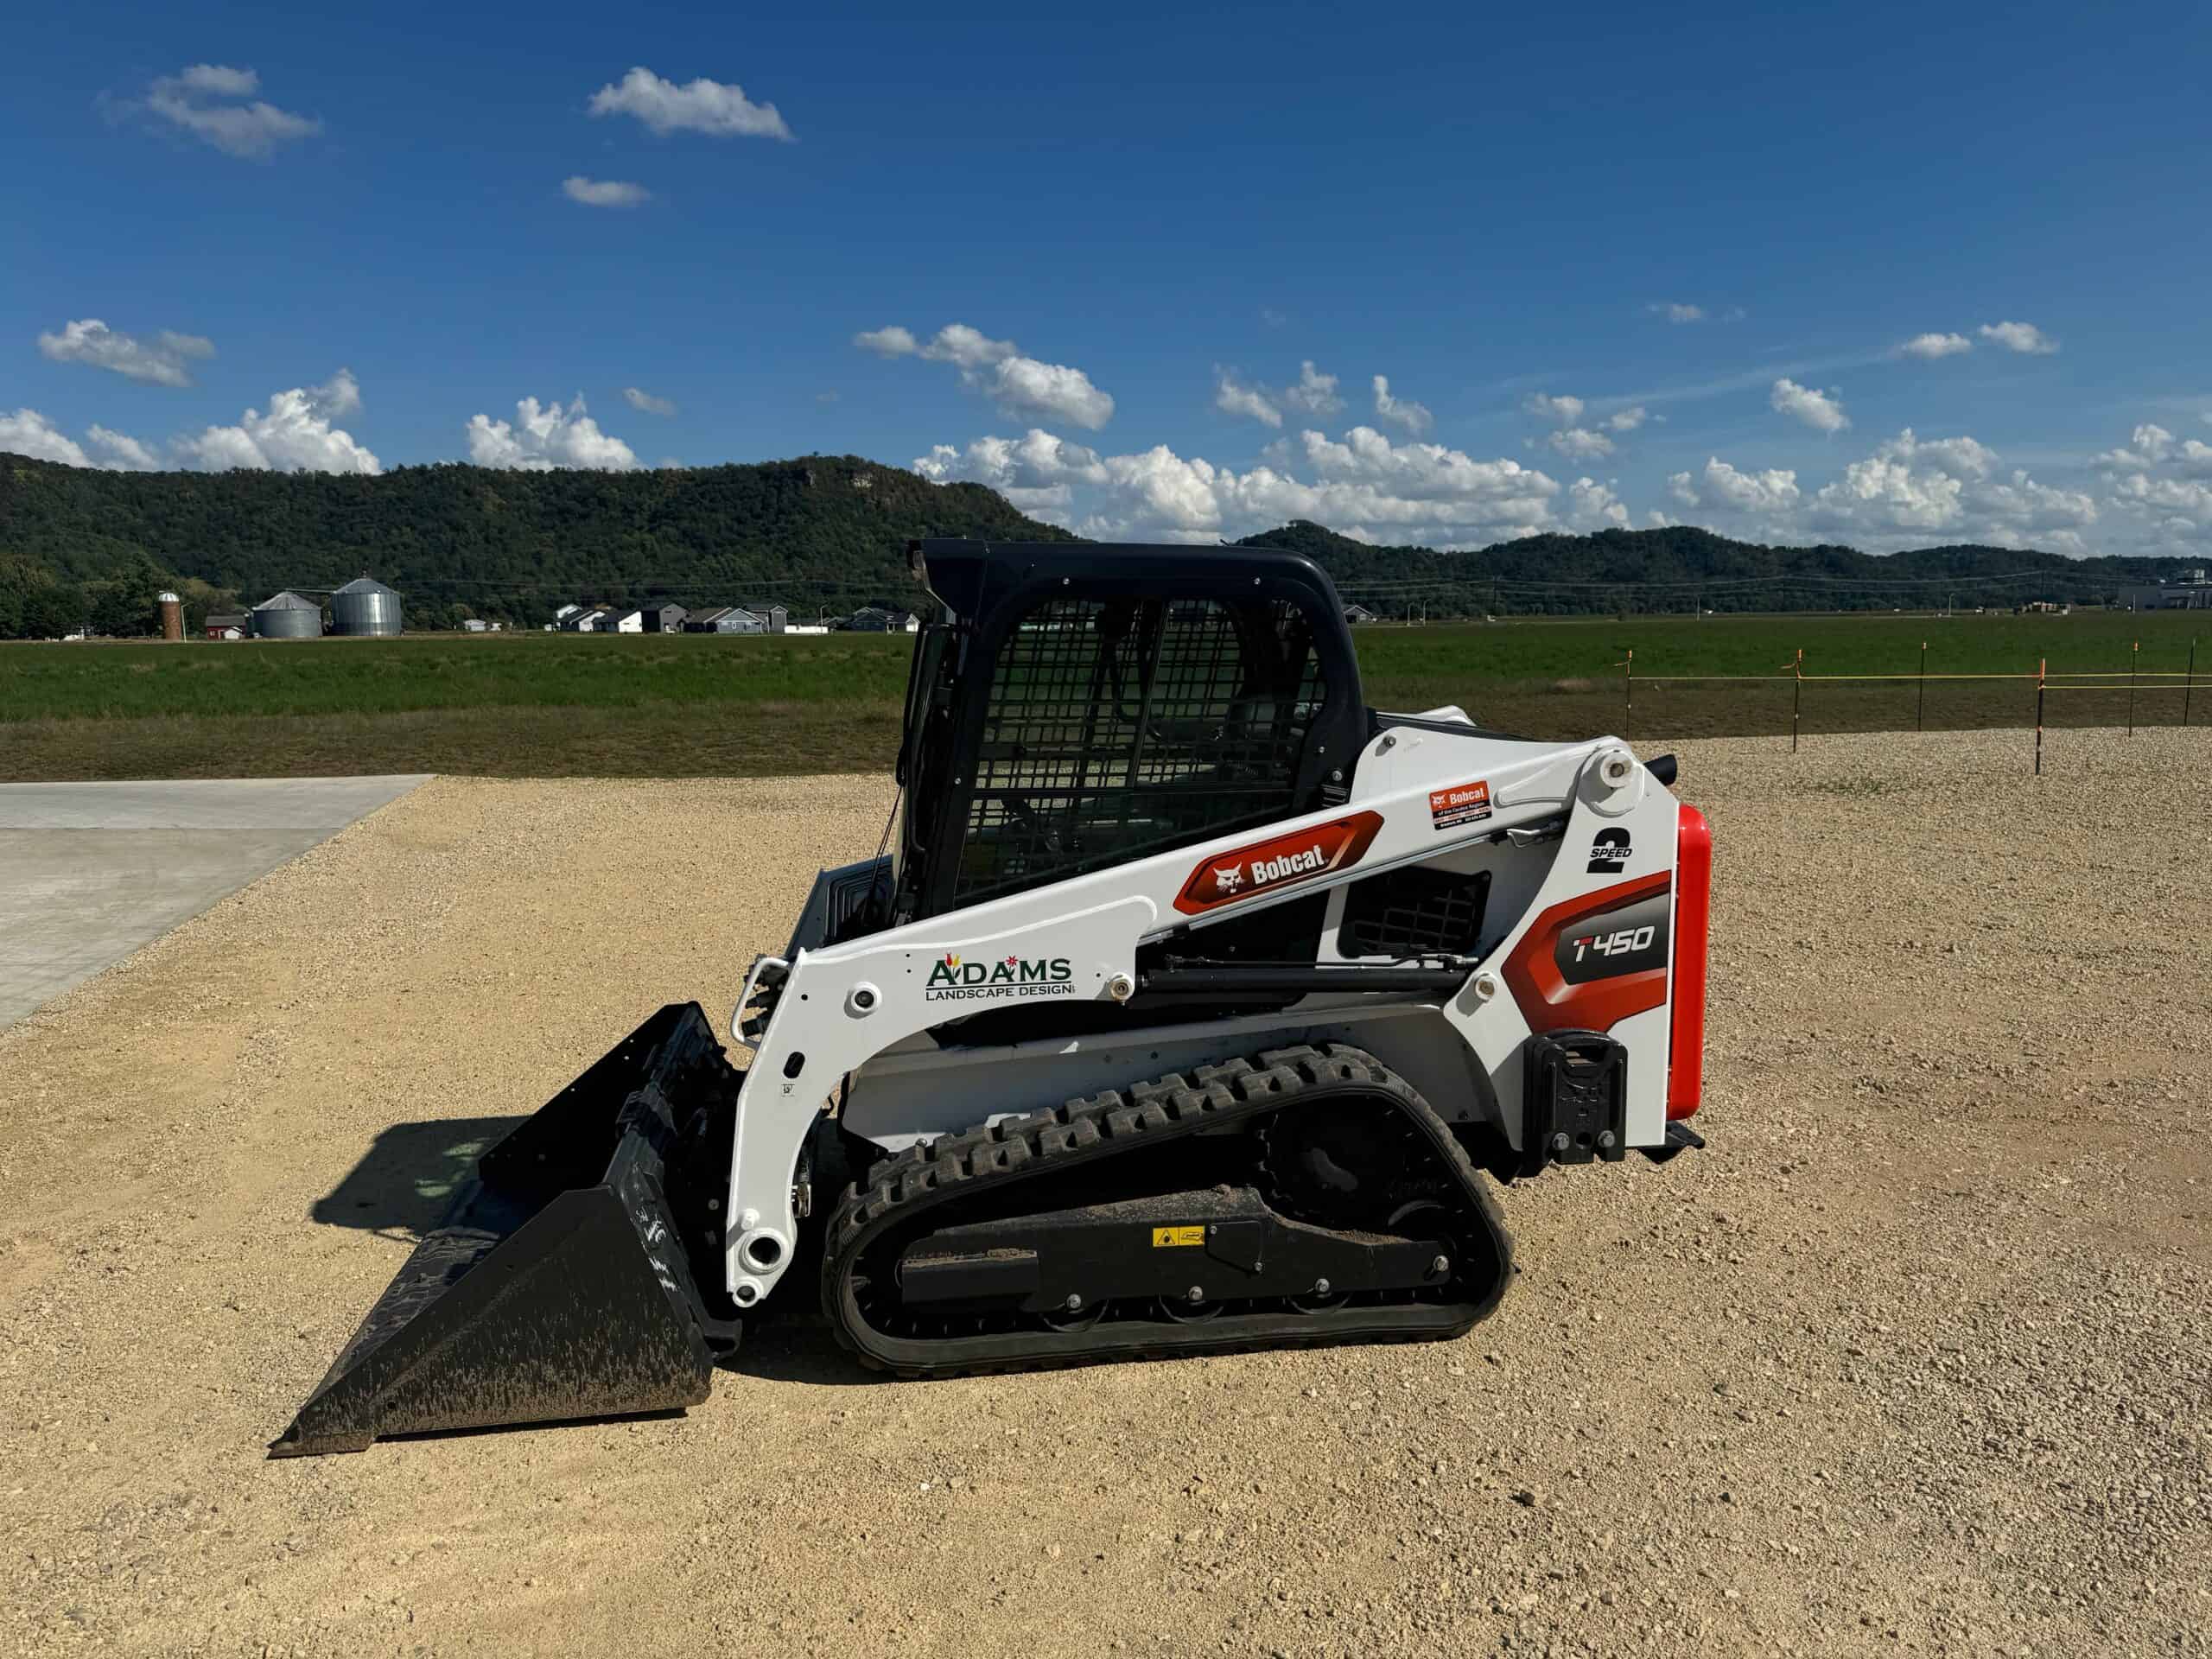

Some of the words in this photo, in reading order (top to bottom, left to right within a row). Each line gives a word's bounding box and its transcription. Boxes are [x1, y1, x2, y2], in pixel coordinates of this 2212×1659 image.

[1449, 787, 1484, 804] Bobcat
[1251, 844, 1325, 885] Bobcat
[1586, 827, 1631, 874] 2
[1590, 849, 1632, 858] SPEED
[1573, 925, 1655, 962] T450
[926, 957, 1071, 987] ADAMS
[925, 987, 1014, 1001] LANDSCAPE
[1019, 984, 1072, 996] DESIGN
